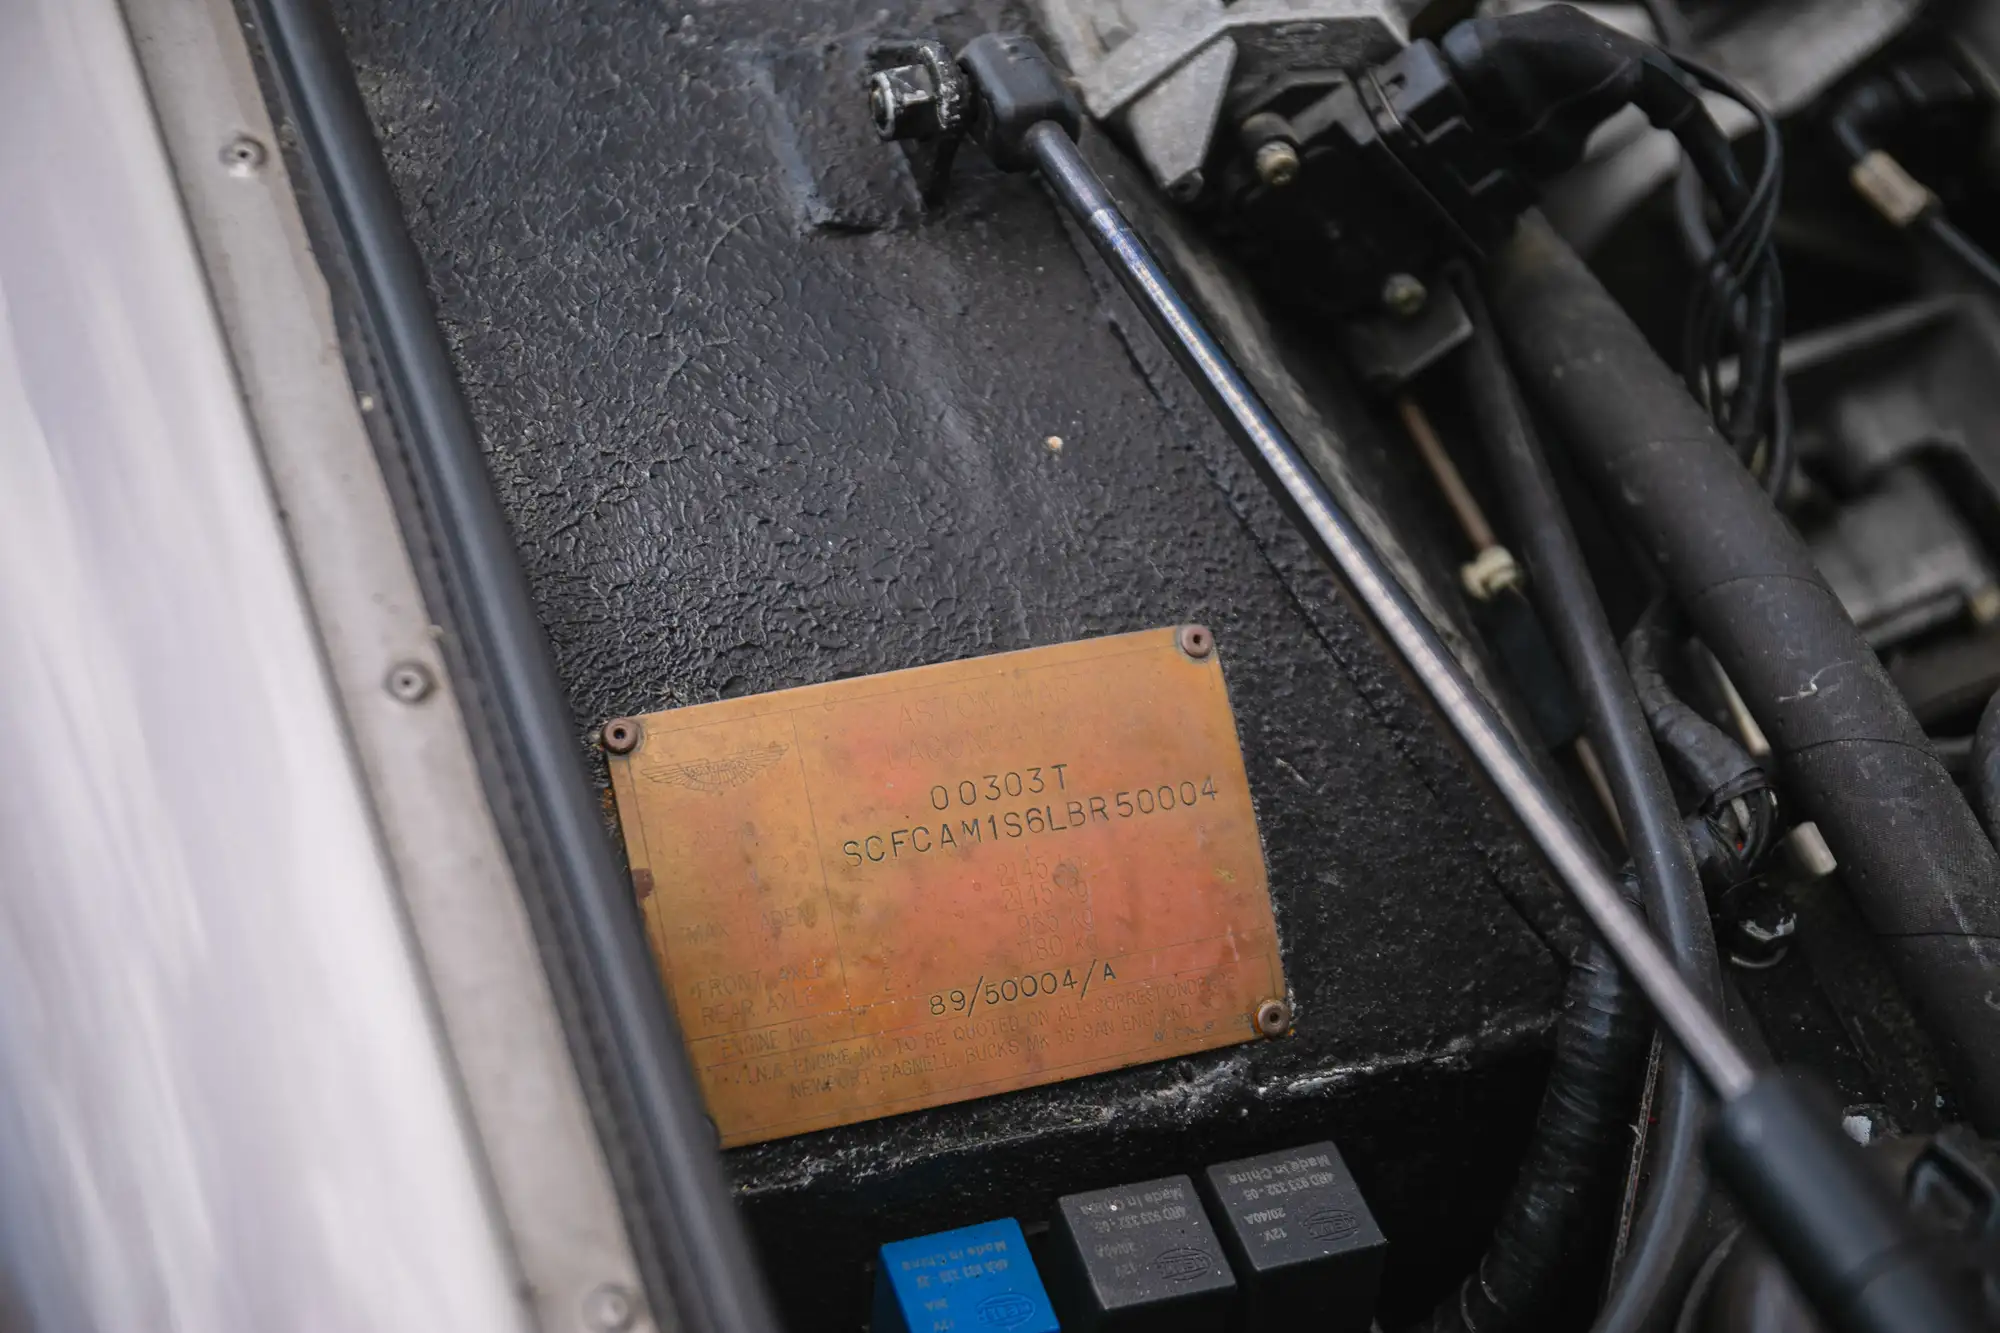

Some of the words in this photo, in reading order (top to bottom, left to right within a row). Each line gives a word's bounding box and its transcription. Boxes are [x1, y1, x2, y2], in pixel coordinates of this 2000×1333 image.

[1122, 1003, 1191, 1030] ENGAND
[1290, 1155, 1329, 1171] Made
[1228, 1168, 1272, 1184] China
